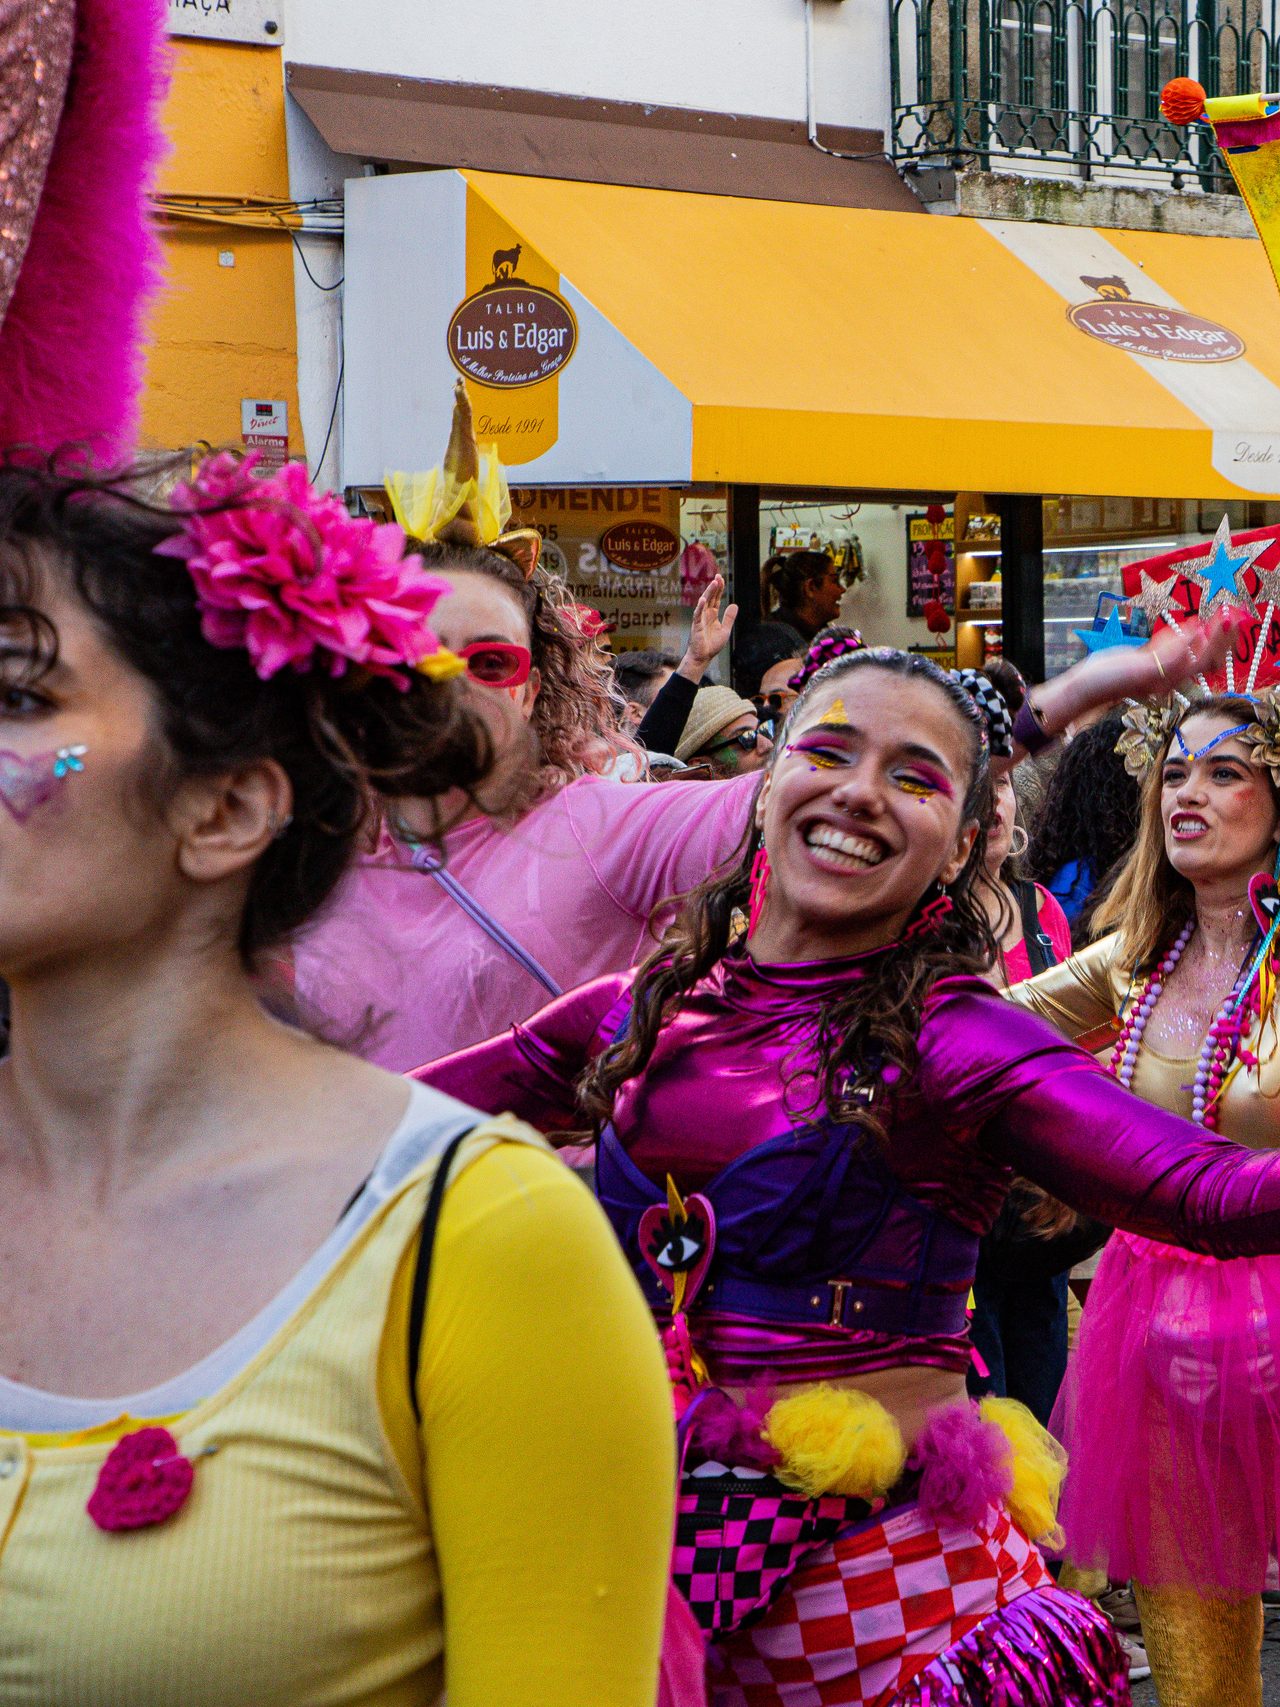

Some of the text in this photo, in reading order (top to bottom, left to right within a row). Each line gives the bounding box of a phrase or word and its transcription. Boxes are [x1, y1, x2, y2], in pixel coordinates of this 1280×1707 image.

[486, 302, 536, 315] TALHO
[1103, 308, 1170, 321] TALHO
[456, 322, 568, 354] Luis & Edgar
[1079, 317, 1229, 346] Luis & Edgar
[477, 415, 545, 435] Desde 1991
[247, 435, 285, 447] Alarme
[1233, 441, 1274, 463] Desde
[607, 538, 632, 551] Luis
[642, 538, 674, 554] Edgar
[602, 608, 672, 628] dgar.pt
